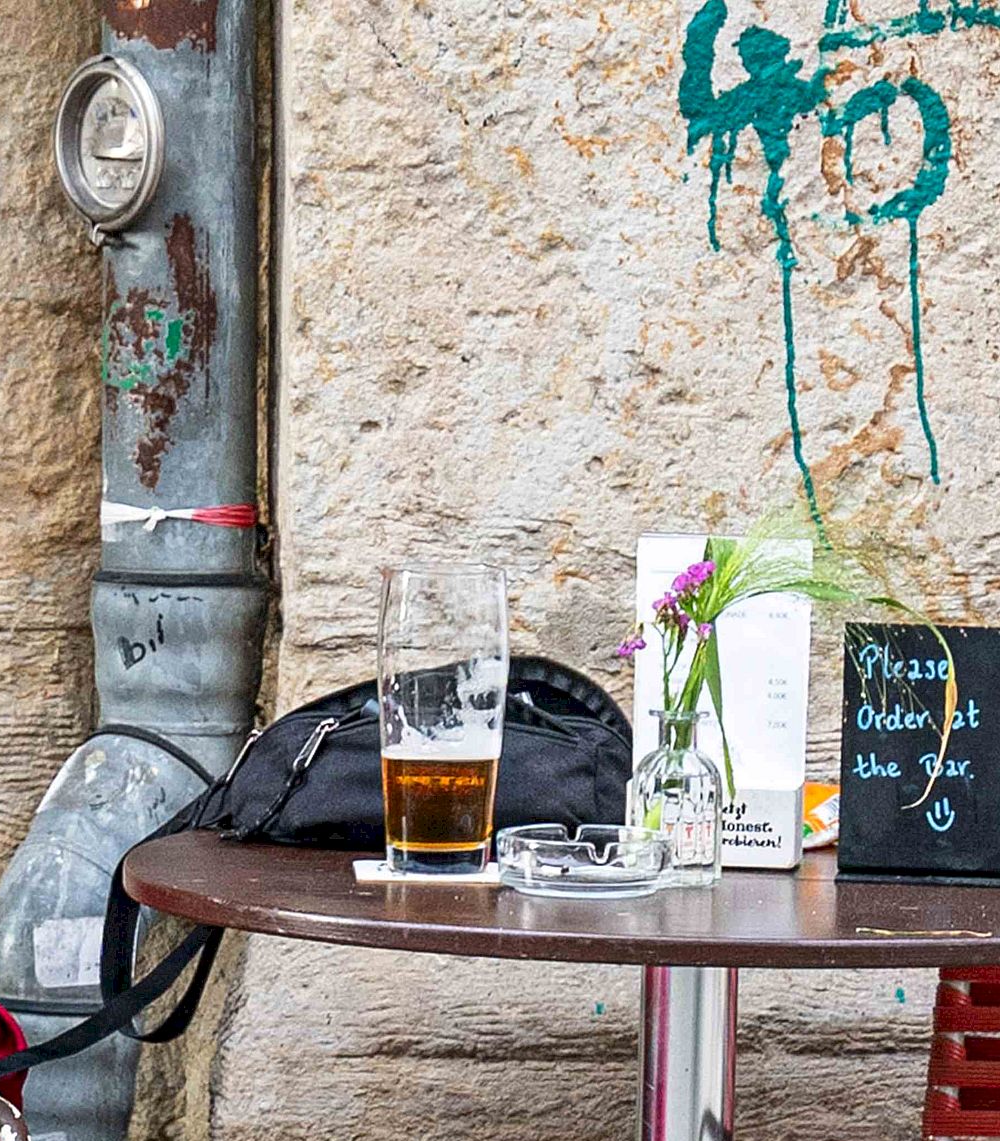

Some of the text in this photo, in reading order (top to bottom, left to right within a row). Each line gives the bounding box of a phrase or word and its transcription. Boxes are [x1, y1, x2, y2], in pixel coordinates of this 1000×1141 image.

[859, 642, 949, 680] Please
[857, 699, 980, 731] Order at
[853, 752, 975, 779] the Bar.
[722, 835, 782, 849] robieren!
